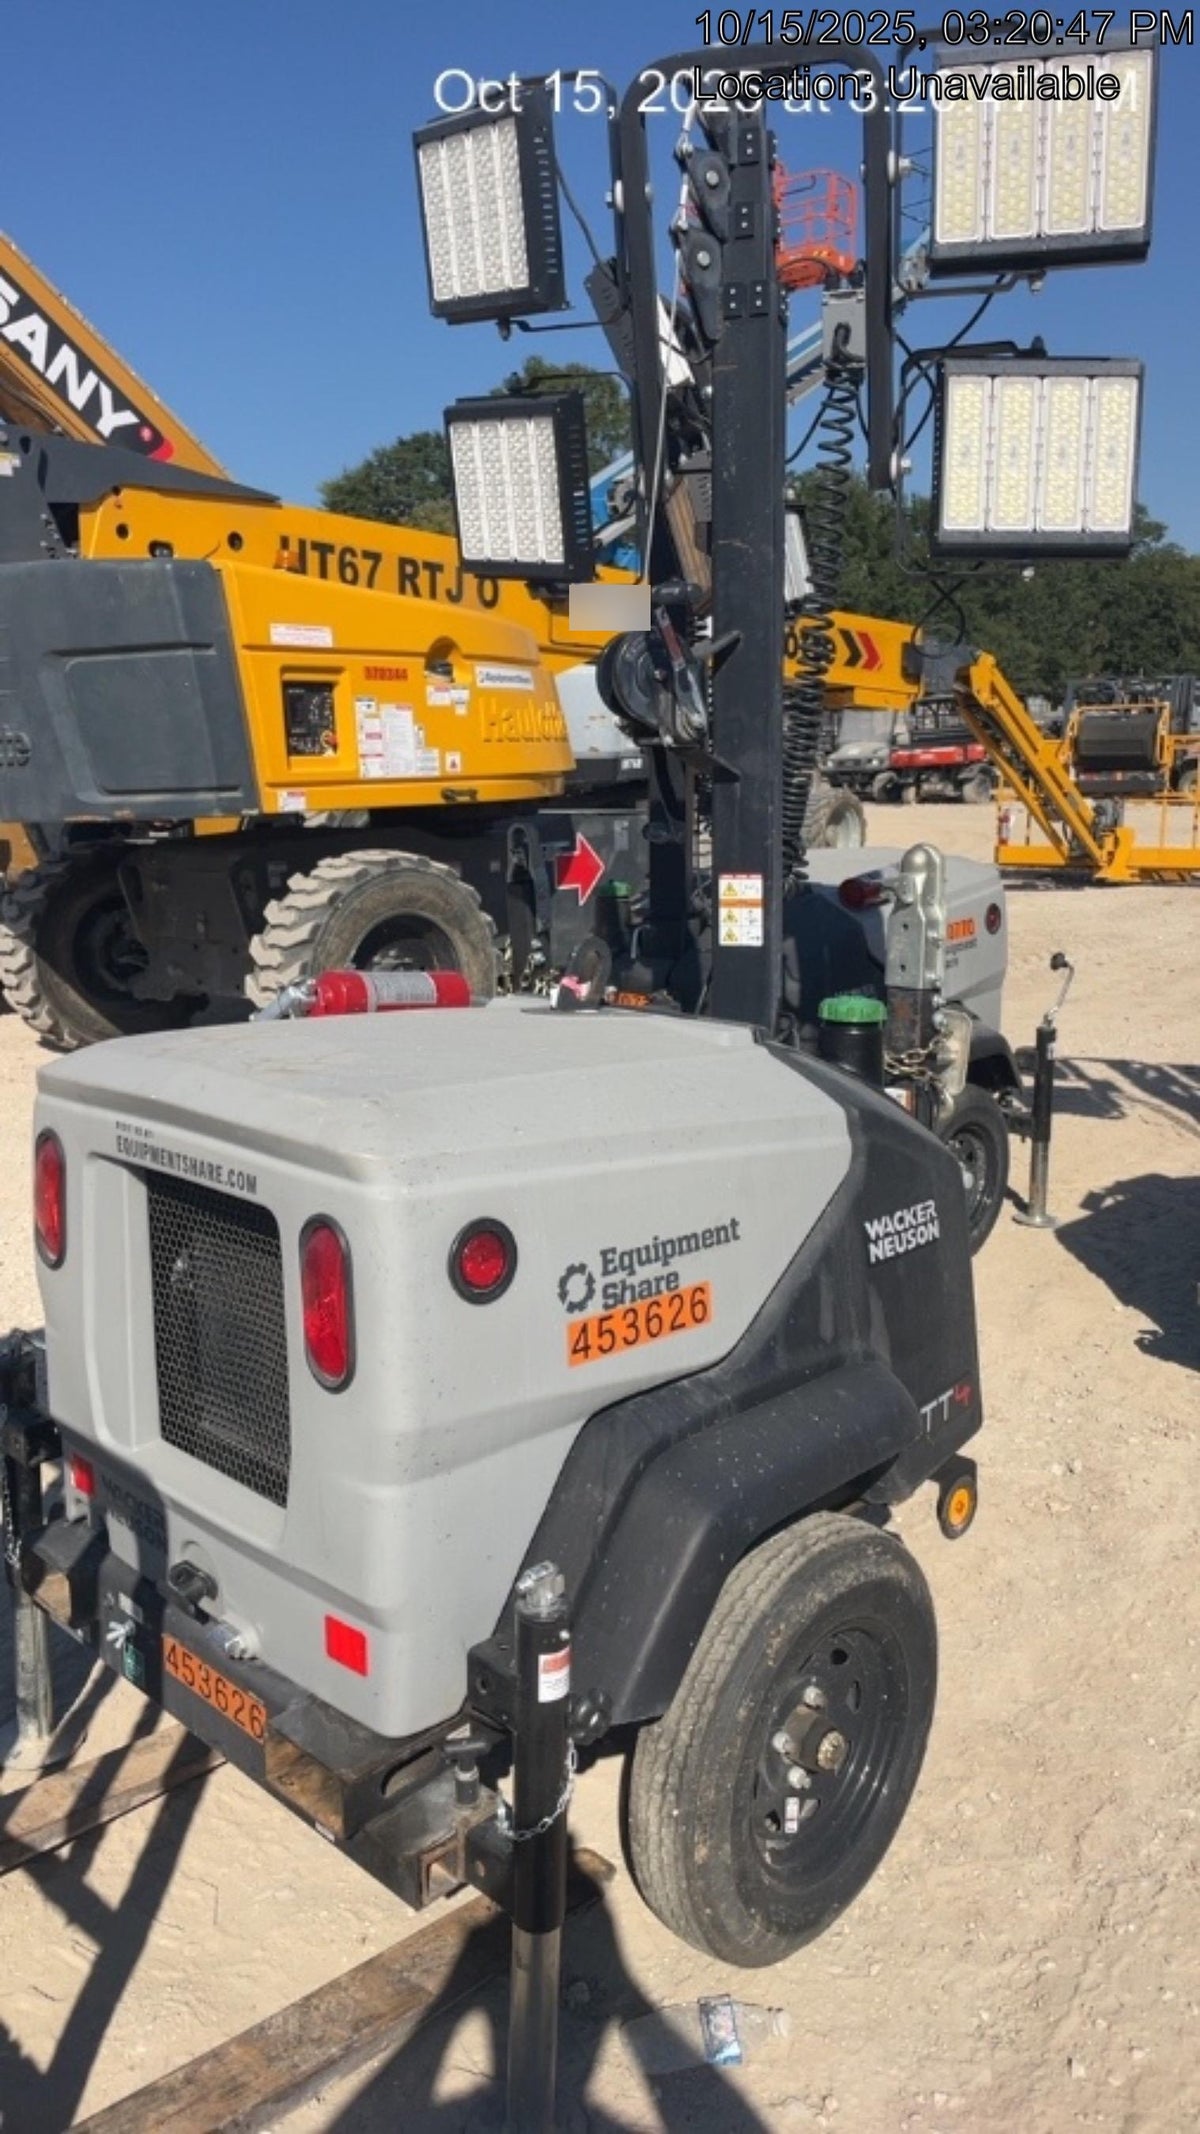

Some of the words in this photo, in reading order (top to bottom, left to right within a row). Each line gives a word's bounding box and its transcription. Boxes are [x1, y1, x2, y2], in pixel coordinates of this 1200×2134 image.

[116, 1135, 257, 1195] EQUIPMENTSHARE.COM
[600, 1217, 741, 1277] Equipment
[864, 1199, 938, 1241] WACKER
[868, 1218, 940, 1265] NEUSON
[601, 1271, 680, 1311] Share
[570, 1286, 708, 1360] 453626
[166, 1643, 265, 1739] 453626
